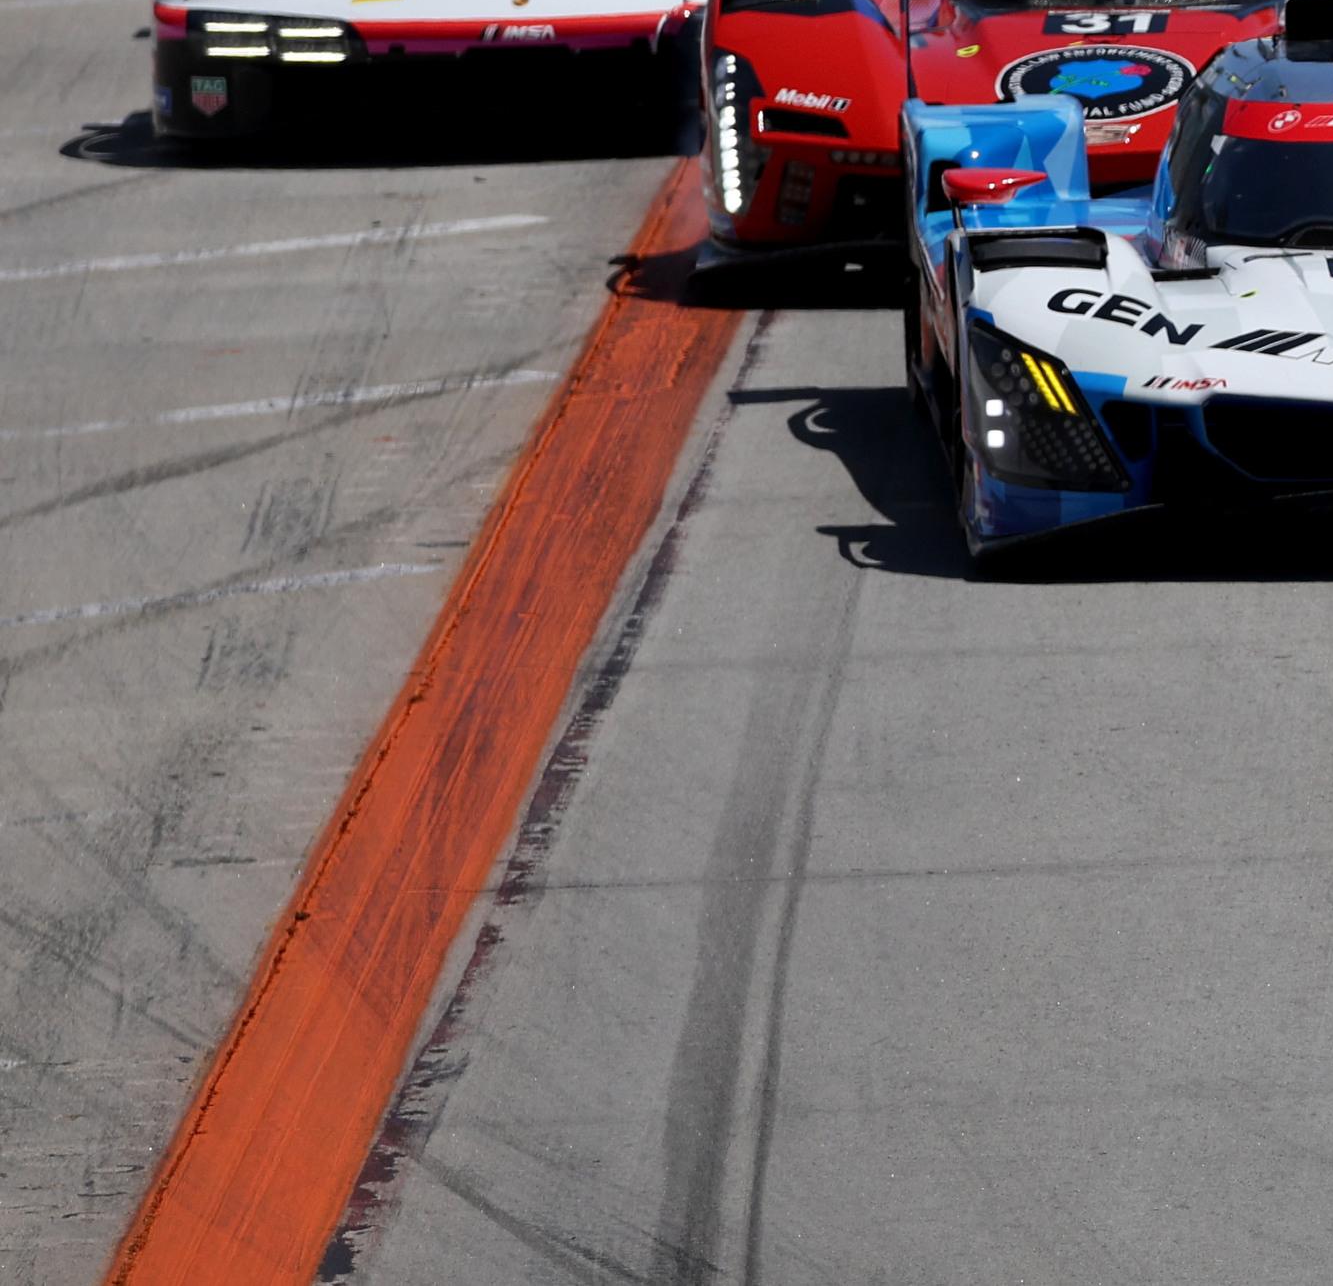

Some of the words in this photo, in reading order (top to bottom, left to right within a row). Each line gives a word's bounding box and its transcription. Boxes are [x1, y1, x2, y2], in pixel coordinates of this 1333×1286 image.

[502, 25, 556, 41] IMSA
[1062, 13, 1153, 34] 31
[774, 87, 831, 110] Mobil
[1118, 92, 1166, 115] FUND
[1047, 288, 1205, 346] GEN
[1172, 378, 1228, 390] IMSA
